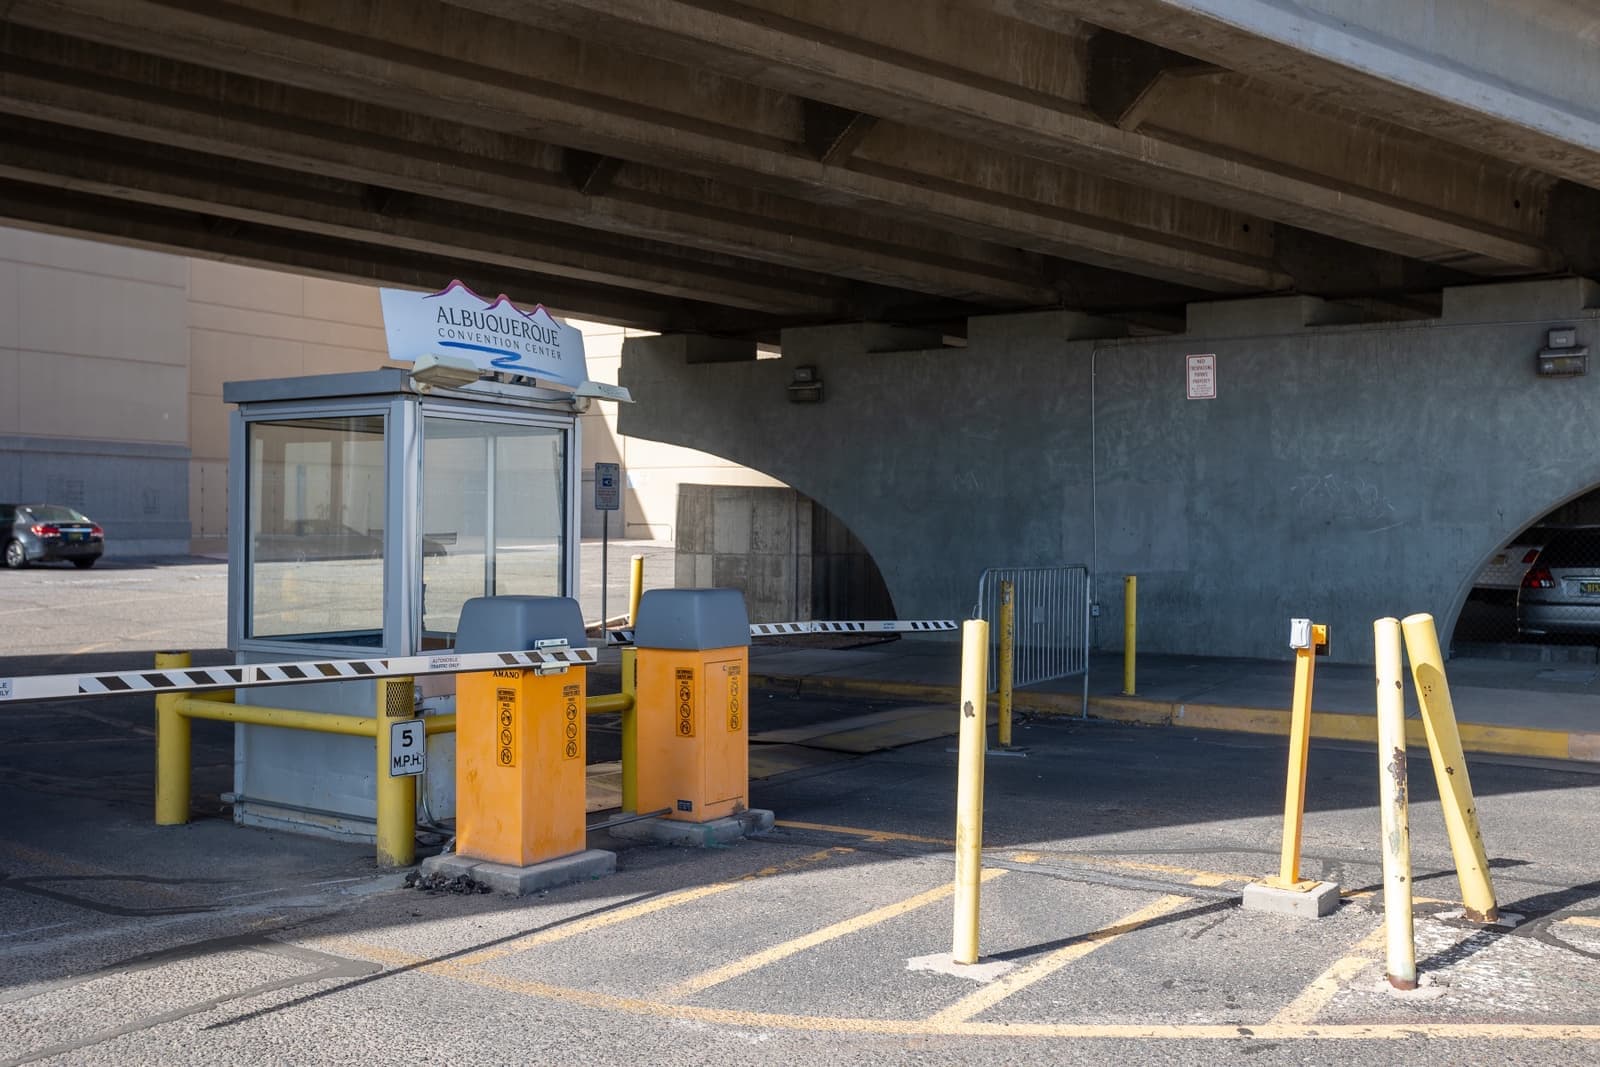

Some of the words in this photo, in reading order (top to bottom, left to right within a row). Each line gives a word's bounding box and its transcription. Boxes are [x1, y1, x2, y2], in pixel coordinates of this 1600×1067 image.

[436, 306, 560, 347] ALBUQUERQUE
[438, 328, 520, 349] CONVENTION
[525, 343, 562, 360] CENTER
[493, 670, 520, 679] AMANO
[402, 729, 413, 747] 5
[393, 753, 422, 769] M.P.H.
